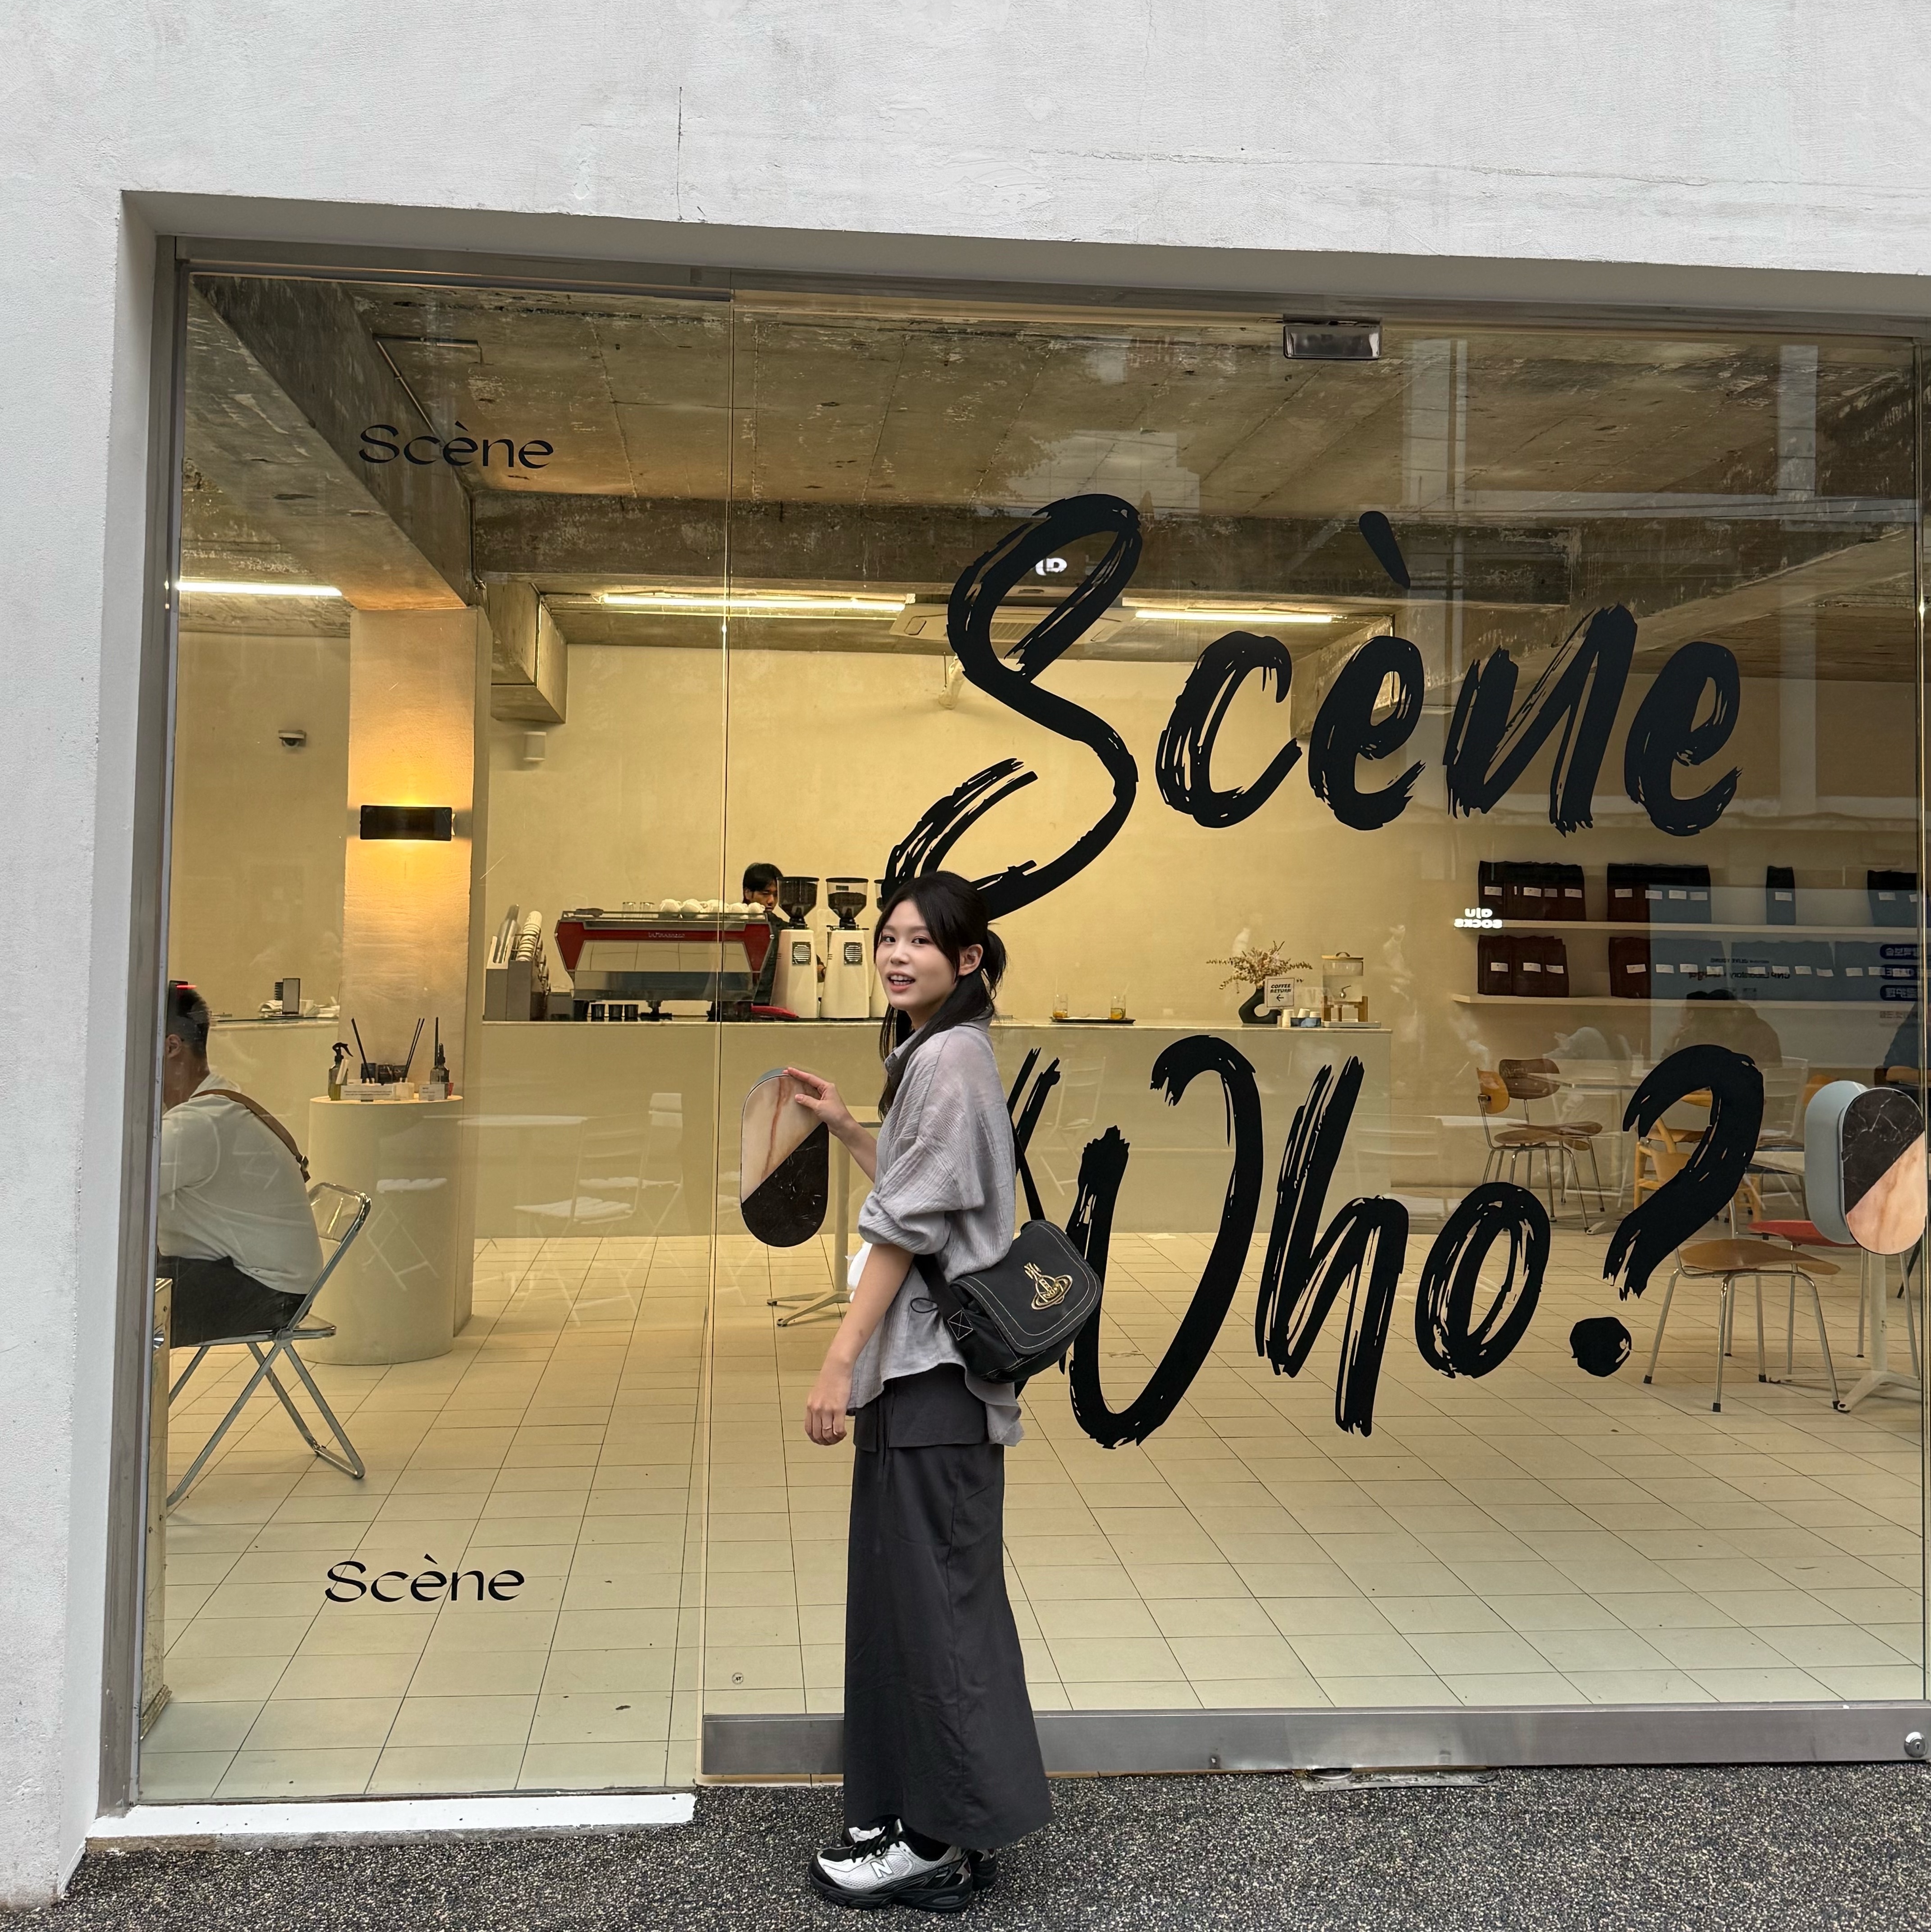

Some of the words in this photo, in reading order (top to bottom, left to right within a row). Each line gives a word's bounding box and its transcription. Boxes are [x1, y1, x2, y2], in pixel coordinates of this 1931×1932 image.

[359, 421, 554, 468] Scène
[881, 493, 1742, 922] Scène
[1006, 1034, 1764, 1450] Who?
[325, 1553, 525, 1602] Scène
